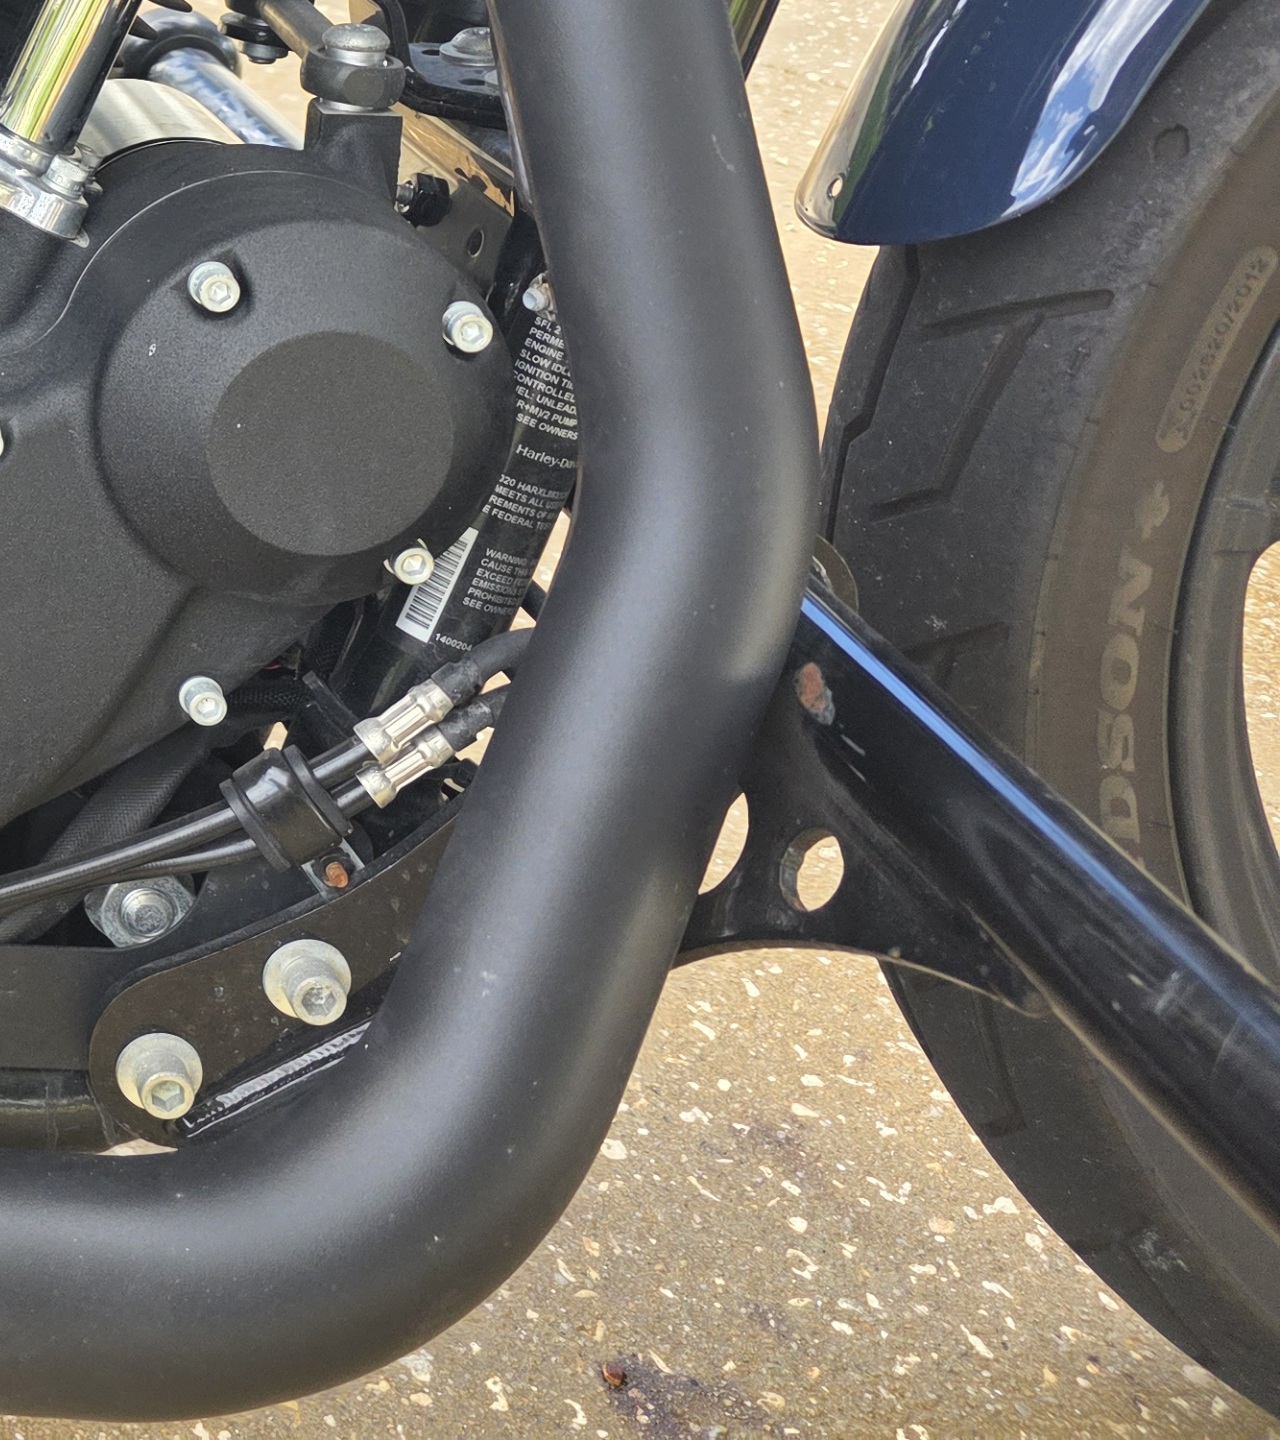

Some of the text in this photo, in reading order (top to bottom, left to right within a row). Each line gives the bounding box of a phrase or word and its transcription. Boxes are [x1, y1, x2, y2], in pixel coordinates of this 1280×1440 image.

[524, 337, 564, 360] ENGINE
[514, 359, 559, 385] IGNITION
[520, 348, 571, 377] SLOW IDL
[516, 398, 578, 427] R+M)/2 PUMP
[536, 394, 577, 415] UNLEAD
[516, 413, 537, 428] SEE
[494, 484, 528, 503] MEETS
[528, 497, 544, 508] ALL
[491, 508, 534, 529] FEDERAL
[476, 567, 513, 584] EXCEED
[481, 558, 513, 574] CAUSE
[462, 597, 483, 610] SEE
